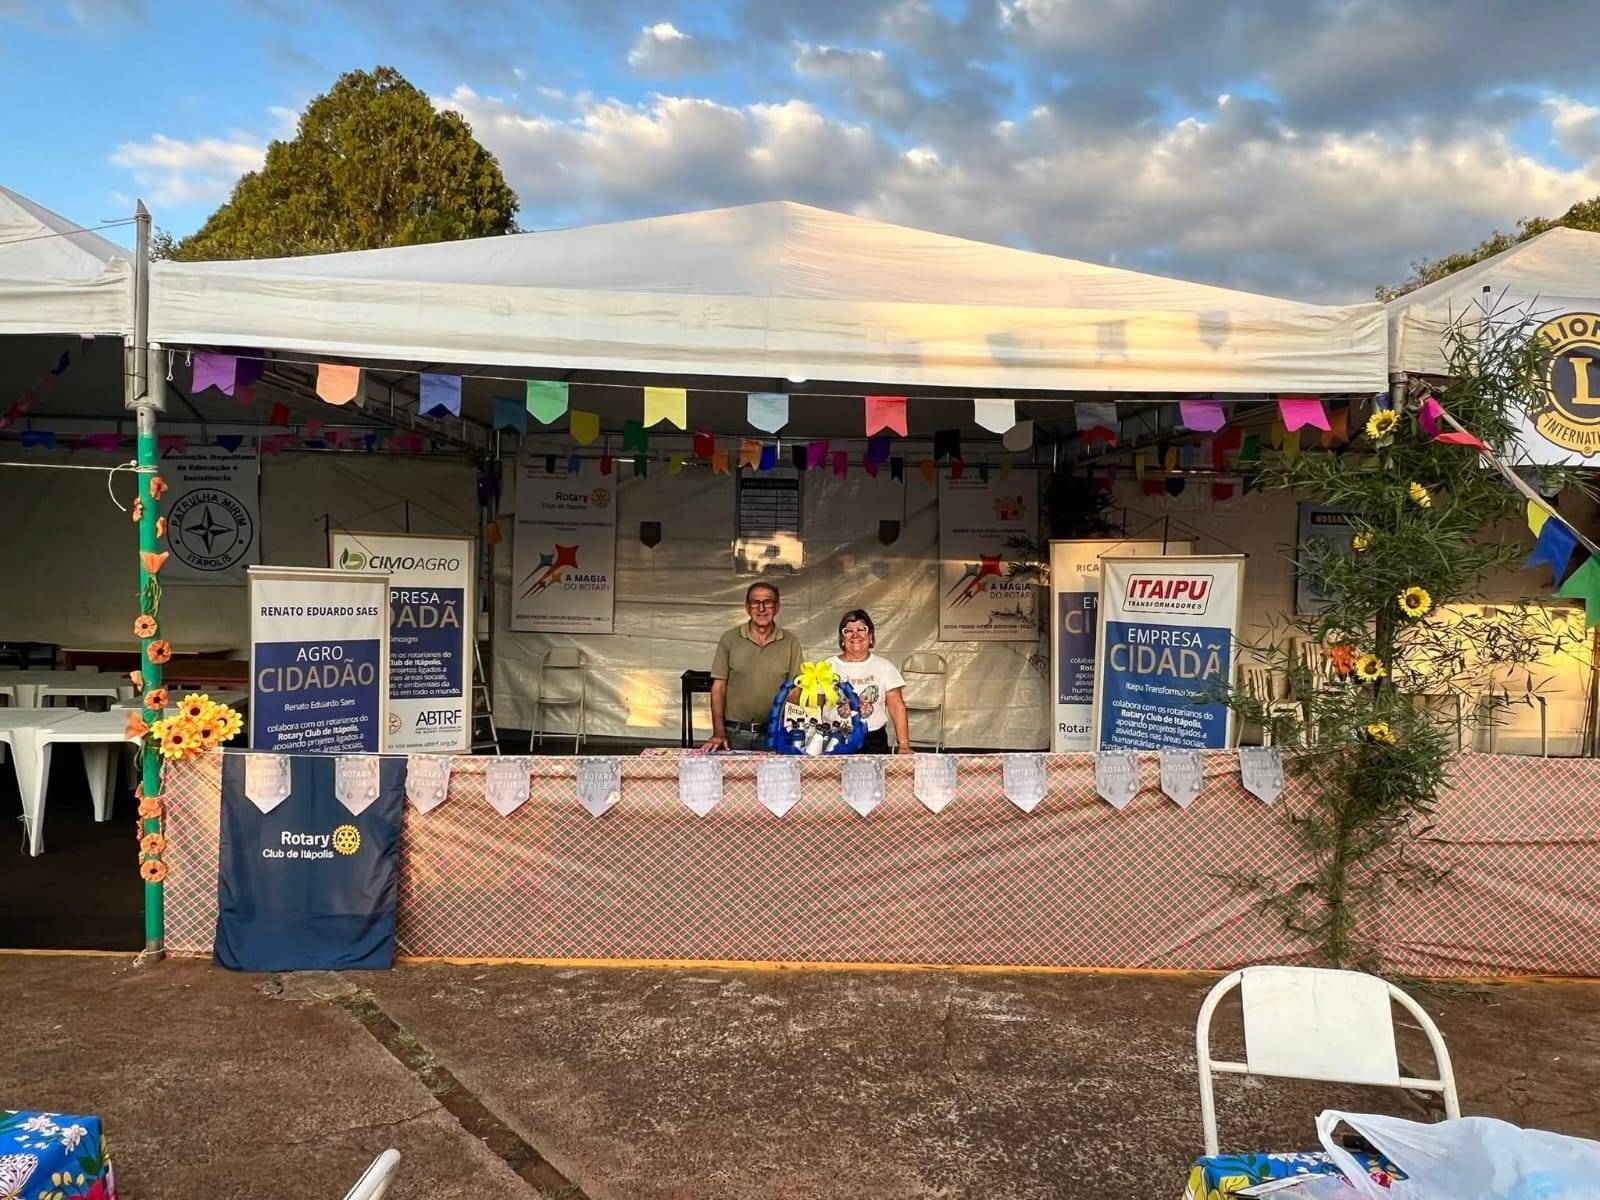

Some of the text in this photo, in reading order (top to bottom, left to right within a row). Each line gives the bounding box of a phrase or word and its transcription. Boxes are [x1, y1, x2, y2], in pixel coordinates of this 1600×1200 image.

[1543, 417, 1600, 446] INTERNATI
[555, 491, 589, 504] Rotary
[171, 493, 219, 528] PATRULHA
[369, 556, 460, 571] CIMOAGRO
[565, 574, 607, 583] A MAGIA
[564, 583, 611, 592] DO ROTARY
[999, 583, 1032, 591] MAGIA
[1129, 579, 1208, 600] ITAIPU
[989, 591, 1002, 600] DO
[260, 606, 378, 617] RENATO EDUARDO SAES
[1128, 600, 1203, 610] TRANSFORMADORES
[1127, 628, 1203, 648] EMPRESA
[296, 645, 343, 662] AGRO
[1110, 643, 1222, 680] CIDADÃ
[258, 658, 374, 693] CIDADÃO
[1125, 682, 1144, 692] Itaipu
[284, 698, 356, 712] Renato Eduardo Saes
[1112, 699, 1214, 720] colabora com os rotarianos do
[267, 723, 299, 733] colabora
[300, 721, 316, 729] com
[359, 714, 369, 722] do
[415, 709, 462, 727] ABTRF
[1121, 709, 1146, 721] Rotary
[1146, 712, 1162, 723] Club
[1163, 716, 1173, 724] de
[278, 731, 303, 742] Rotary
[305, 728, 321, 738] Club
[322, 727, 332, 735] de
[1115, 718, 1148, 729] apoiando
[1148, 722, 1177, 734] projetos
[1177, 726, 1201, 739] ligados
[1115, 727, 1149, 738] atividades
[1149, 732, 1161, 741] nas
[1167, 764, 1195, 772] ROTARY
[584, 772, 613, 781] ROTARY
[281, 831, 330, 848] Rotary
[262, 849, 334, 860] Club de Itápolis
